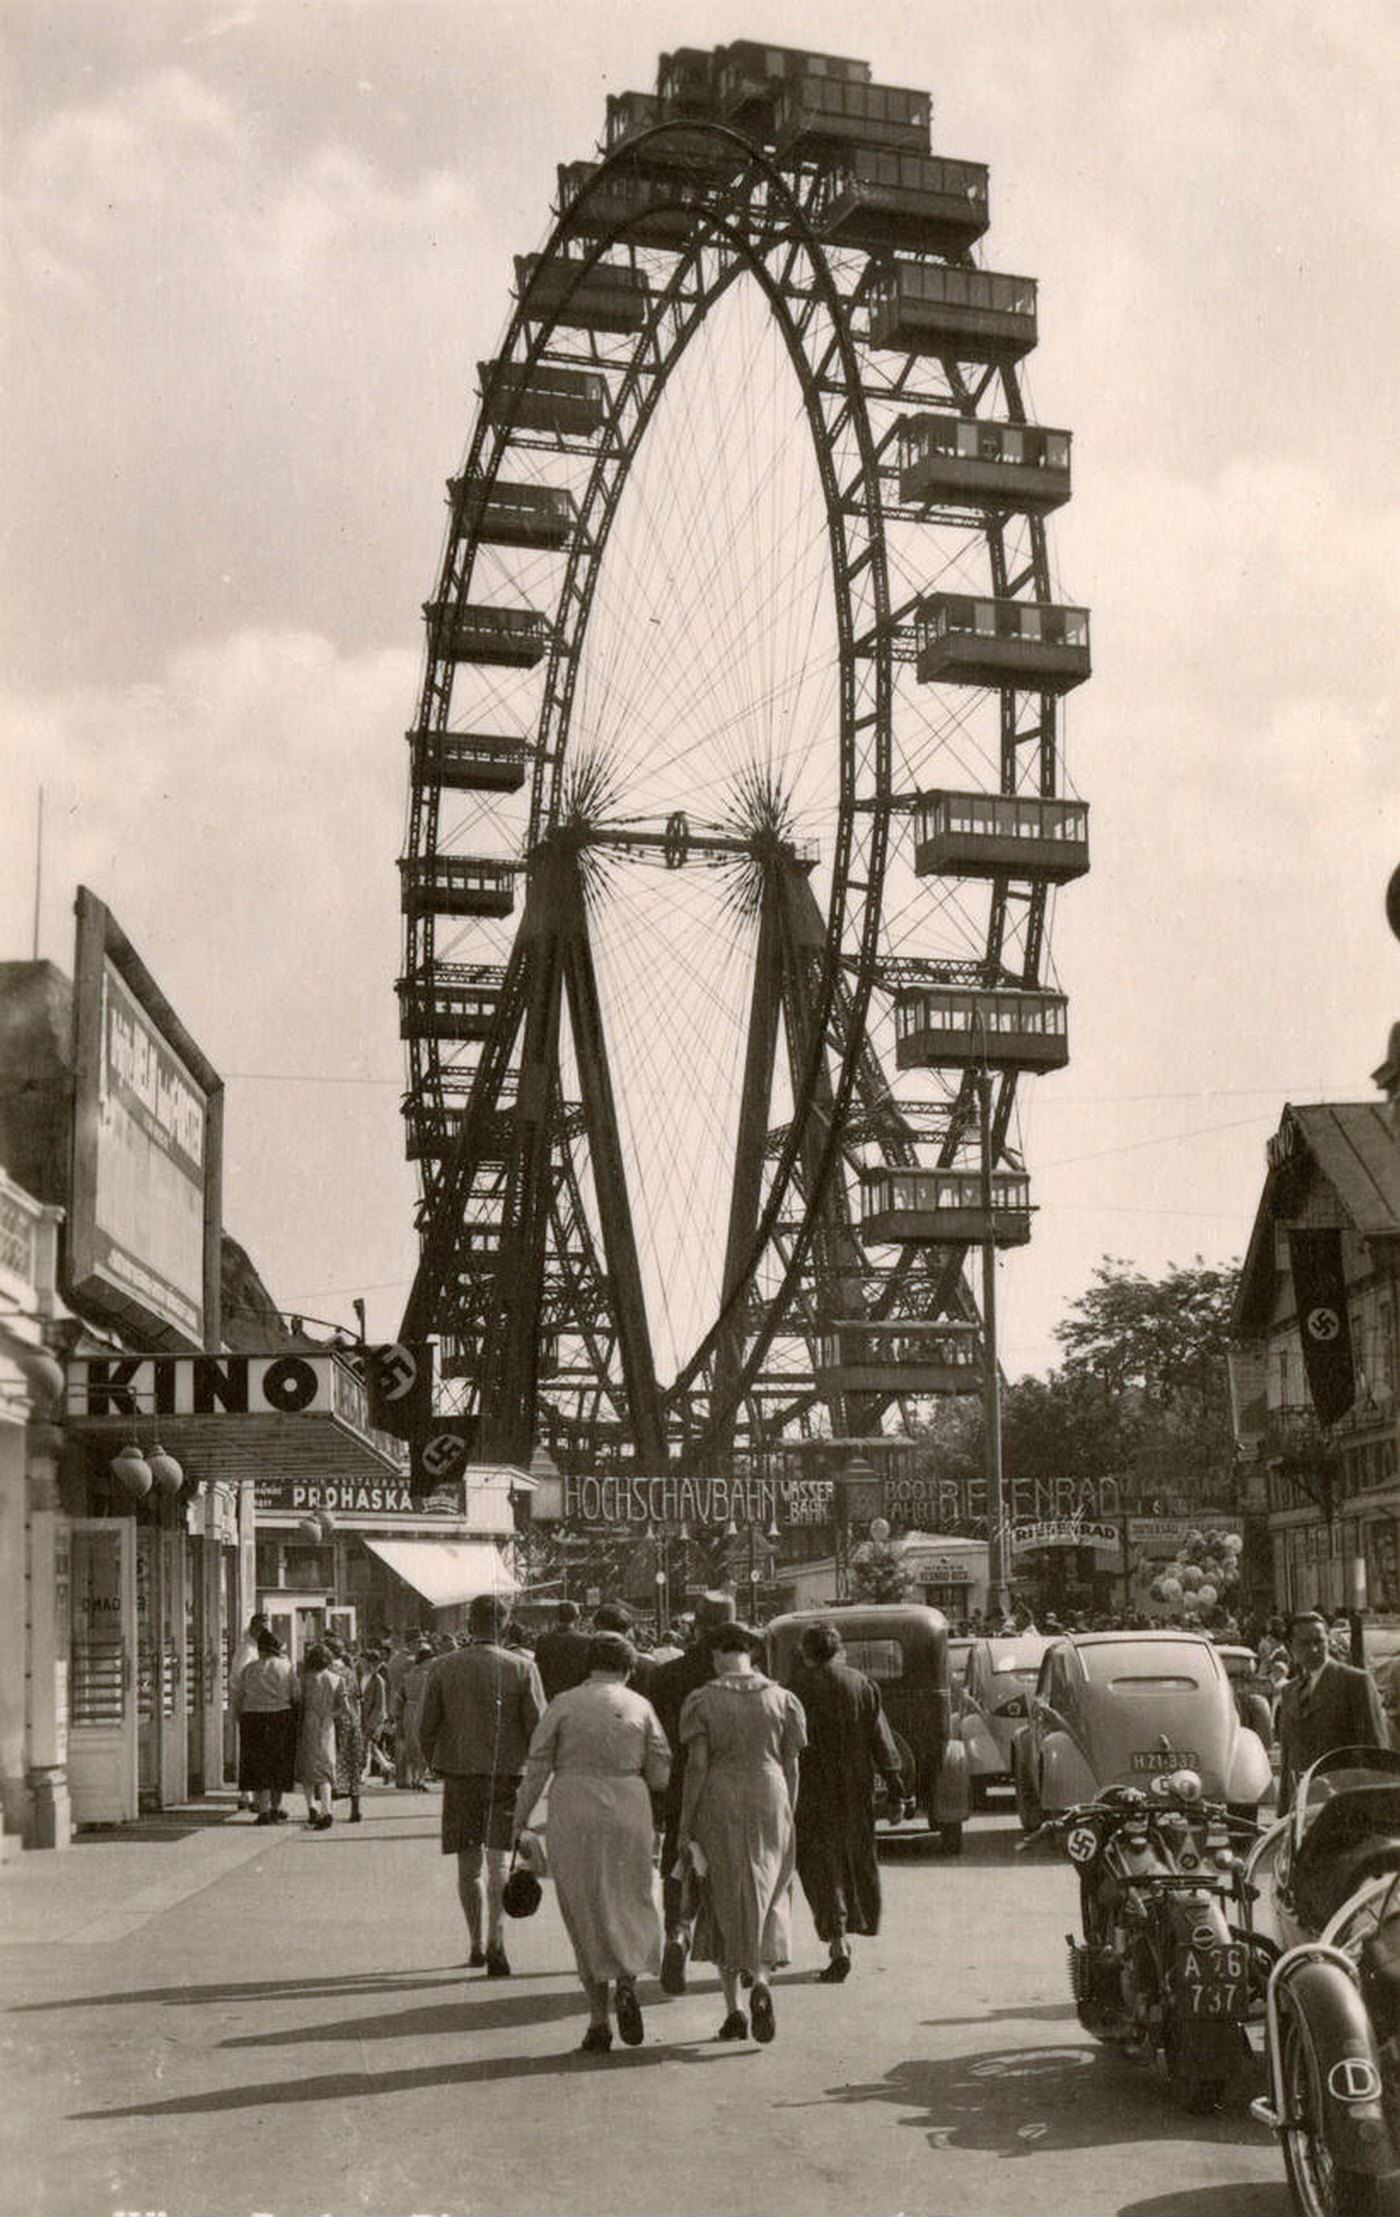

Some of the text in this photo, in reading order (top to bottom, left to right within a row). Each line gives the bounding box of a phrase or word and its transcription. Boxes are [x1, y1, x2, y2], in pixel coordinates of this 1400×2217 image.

[88, 1357, 319, 1413] KINO
[293, 1486, 413, 1511] PROHASKA
[939, 1477, 1119, 1520] RIEENRAD
